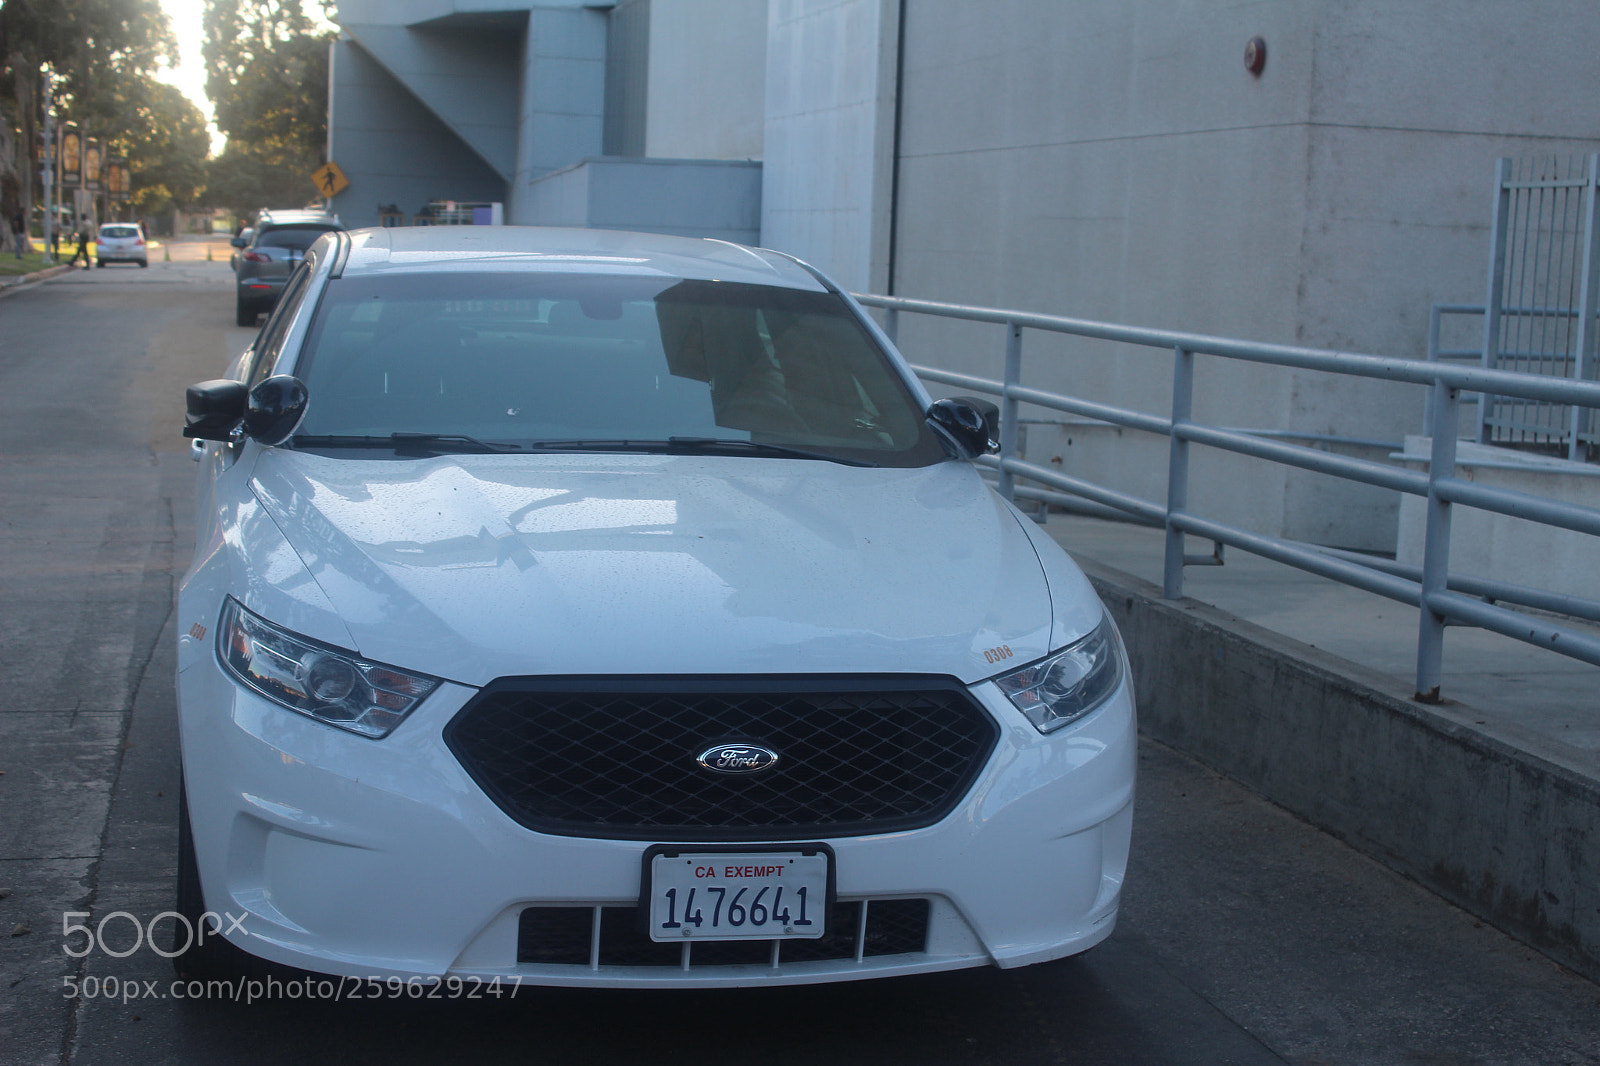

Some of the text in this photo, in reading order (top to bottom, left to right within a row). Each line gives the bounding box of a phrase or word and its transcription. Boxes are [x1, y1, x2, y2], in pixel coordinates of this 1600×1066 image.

[984, 644, 1013, 664] 0308
[716, 749, 760, 768] Ford
[695, 865, 785, 878] CA EXEMPT
[661, 886, 812, 928] 1476641
